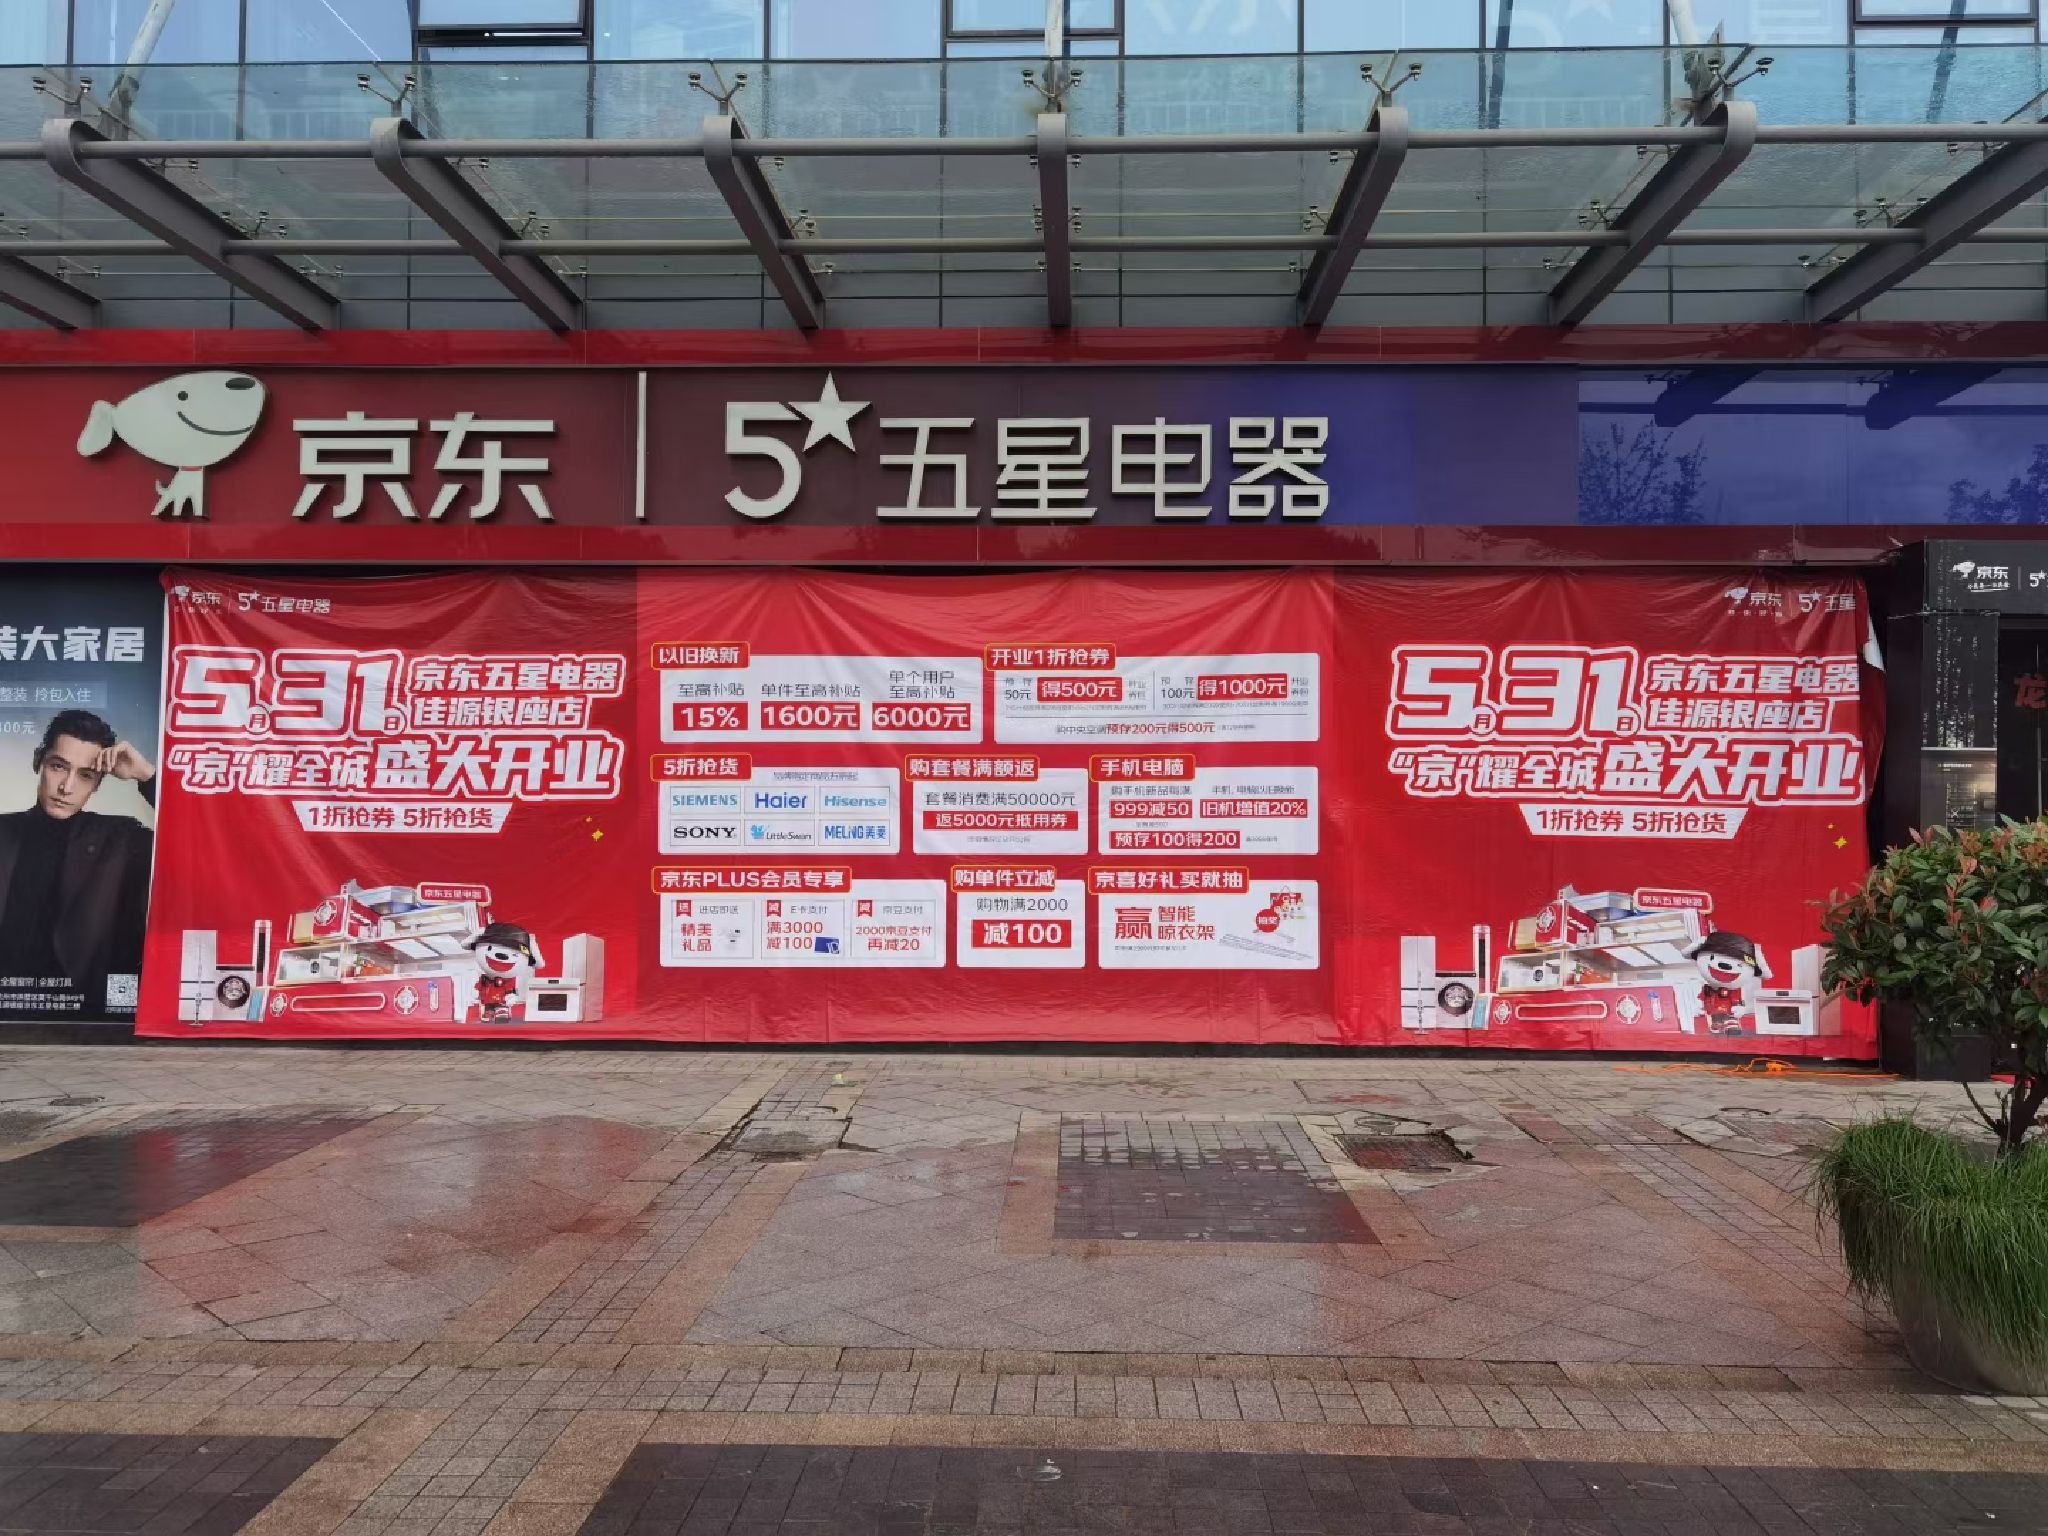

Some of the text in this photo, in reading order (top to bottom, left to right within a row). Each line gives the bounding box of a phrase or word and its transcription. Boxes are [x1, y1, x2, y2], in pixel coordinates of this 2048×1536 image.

[291, 411, 555, 519] 京东
[1977, 566, 2008, 579] 京东
[192, 591, 222, 604] 京东
[1750, 592, 1781, 606] 京东
[659, 647, 739, 664] 以旧换新
[991, 648, 1109, 666] 开业1折抢券
[415, 658, 618, 692] 京东五星电器
[889, 670, 955, 684] 单个用户
[1648, 662, 1859, 695] 京东五星电器
[35, 687, 91, 700] 拎包入住
[678, 683, 745, 697] 至高补贴
[761, 683, 861, 698] 单件至高补贴
[889, 685, 955, 699] 至高补贴
[1004, 689, 1031, 700] 50元
[1041, 680, 1117, 698] 得500元
[1161, 687, 1194, 699] 100元
[1199, 677, 1286, 696] 得1000元
[415, 696, 583, 727] 佳源银座店
[681, 707, 739, 728] 15%
[763, 706, 859, 728] 1600元
[873, 706, 969, 728] 6000元
[1646, 699, 1825, 730] 佳源银座店
[0, 721, 35, 734] 00元
[663, 758, 738, 776] 5折抢货
[910, 759, 1035, 778] 购套餐满额返
[1100, 758, 1184, 776] 手机电脑
[672, 792, 887, 808] SIEMENS Haier Hisense
[925, 792, 1076, 806] 套餐消费满50000元
[1114, 802, 1189, 817] 999减50
[1202, 801, 1307, 816] 旧机增值20%
[308, 807, 493, 828] 1折抢券 5折抢货
[936, 813, 1068, 828] 返5000元抵用券
[1536, 809, 1728, 833] 1折抢券 5折抢货
[674, 826, 736, 839] SONY
[1115, 832, 1237, 848] 预存100得200
[660, 871, 844, 888] 京东PLUS会员专享
[955, 869, 1055, 888] 购单件立减
[1094, 870, 1244, 889] 京喜好礼买就抽
[976, 897, 1068, 912] 购物满2000
[1158, 905, 1196, 923] 智能
[680, 923, 712, 937] 精美
[767, 921, 823, 934] 满3000
[1115, 906, 1153, 940] 赢
[983, 922, 1062, 945] 减100
[1158, 924, 1216, 941] 晾衣架
[681, 938, 712, 952] 礼品
[766, 936, 812, 950] 减100
[867, 938, 920, 952] 再减20
